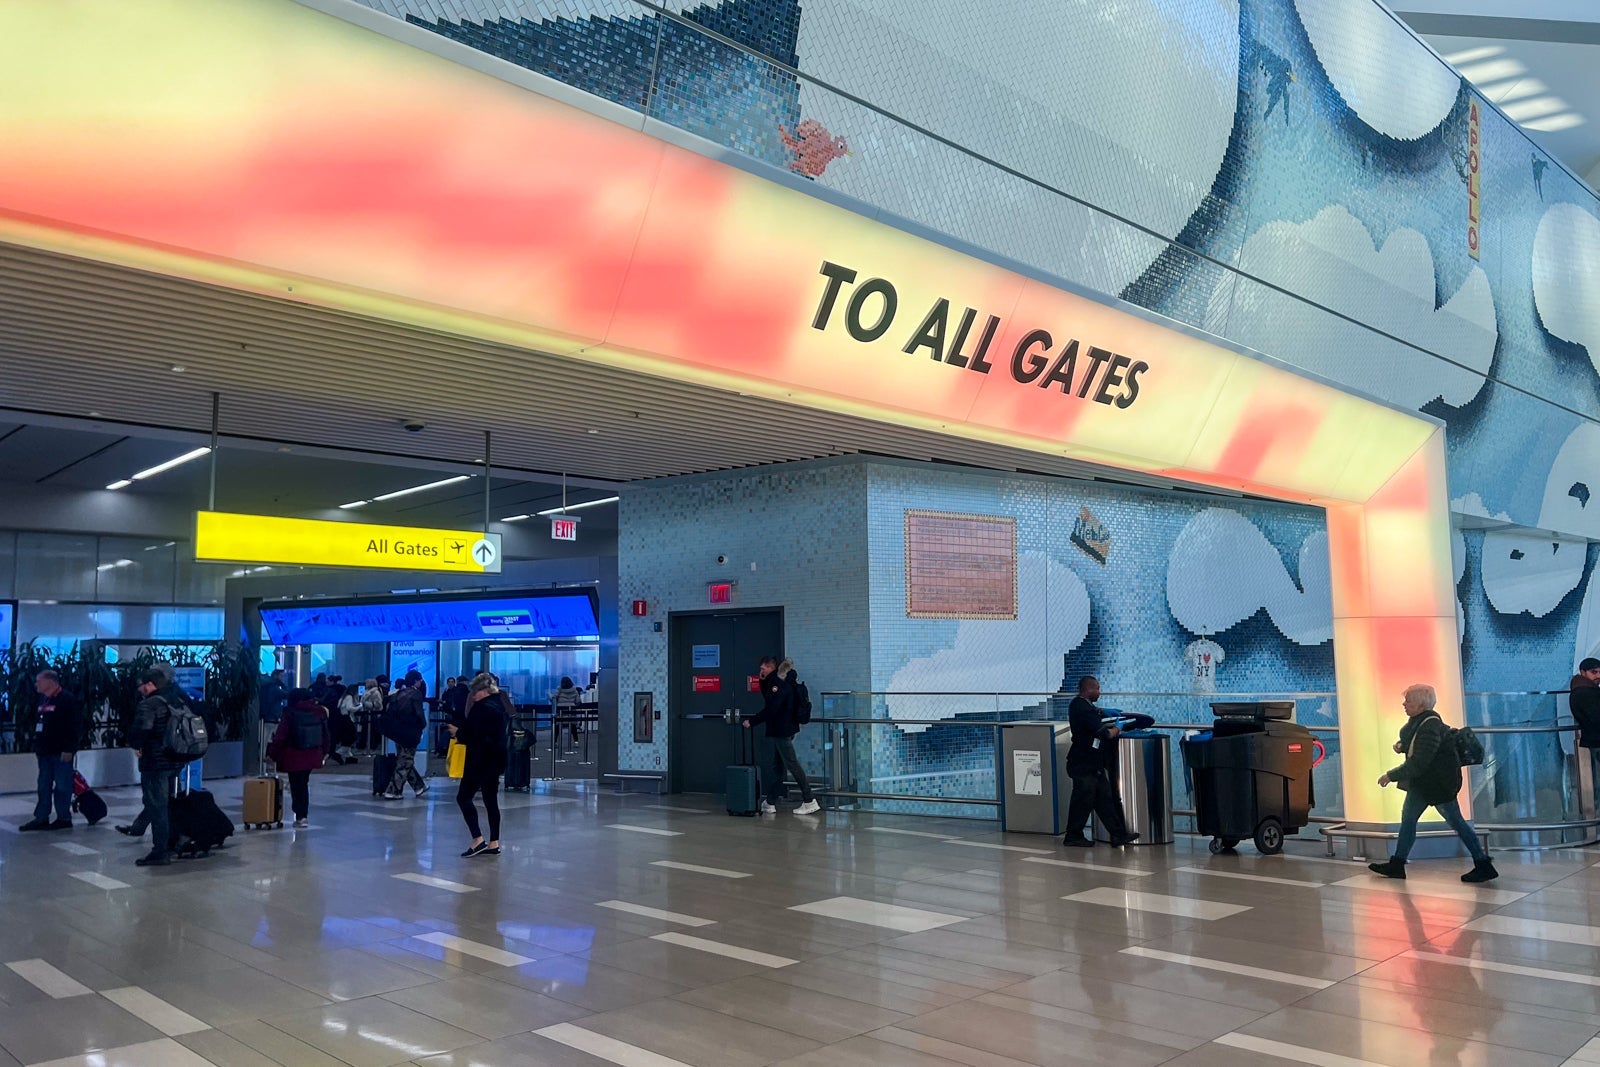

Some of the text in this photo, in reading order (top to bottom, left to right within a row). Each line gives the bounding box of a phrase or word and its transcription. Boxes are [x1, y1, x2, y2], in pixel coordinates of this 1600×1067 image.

[1468, 104, 1478, 250] APOLLO
[811, 260, 1150, 409] TO ALL GATES
[555, 520, 574, 538] EXIT
[366, 539, 438, 557] All Gates
[711, 585, 729, 602] EXIT
[393, 648, 435, 656] companion
[1196, 666, 1210, 677] NY
